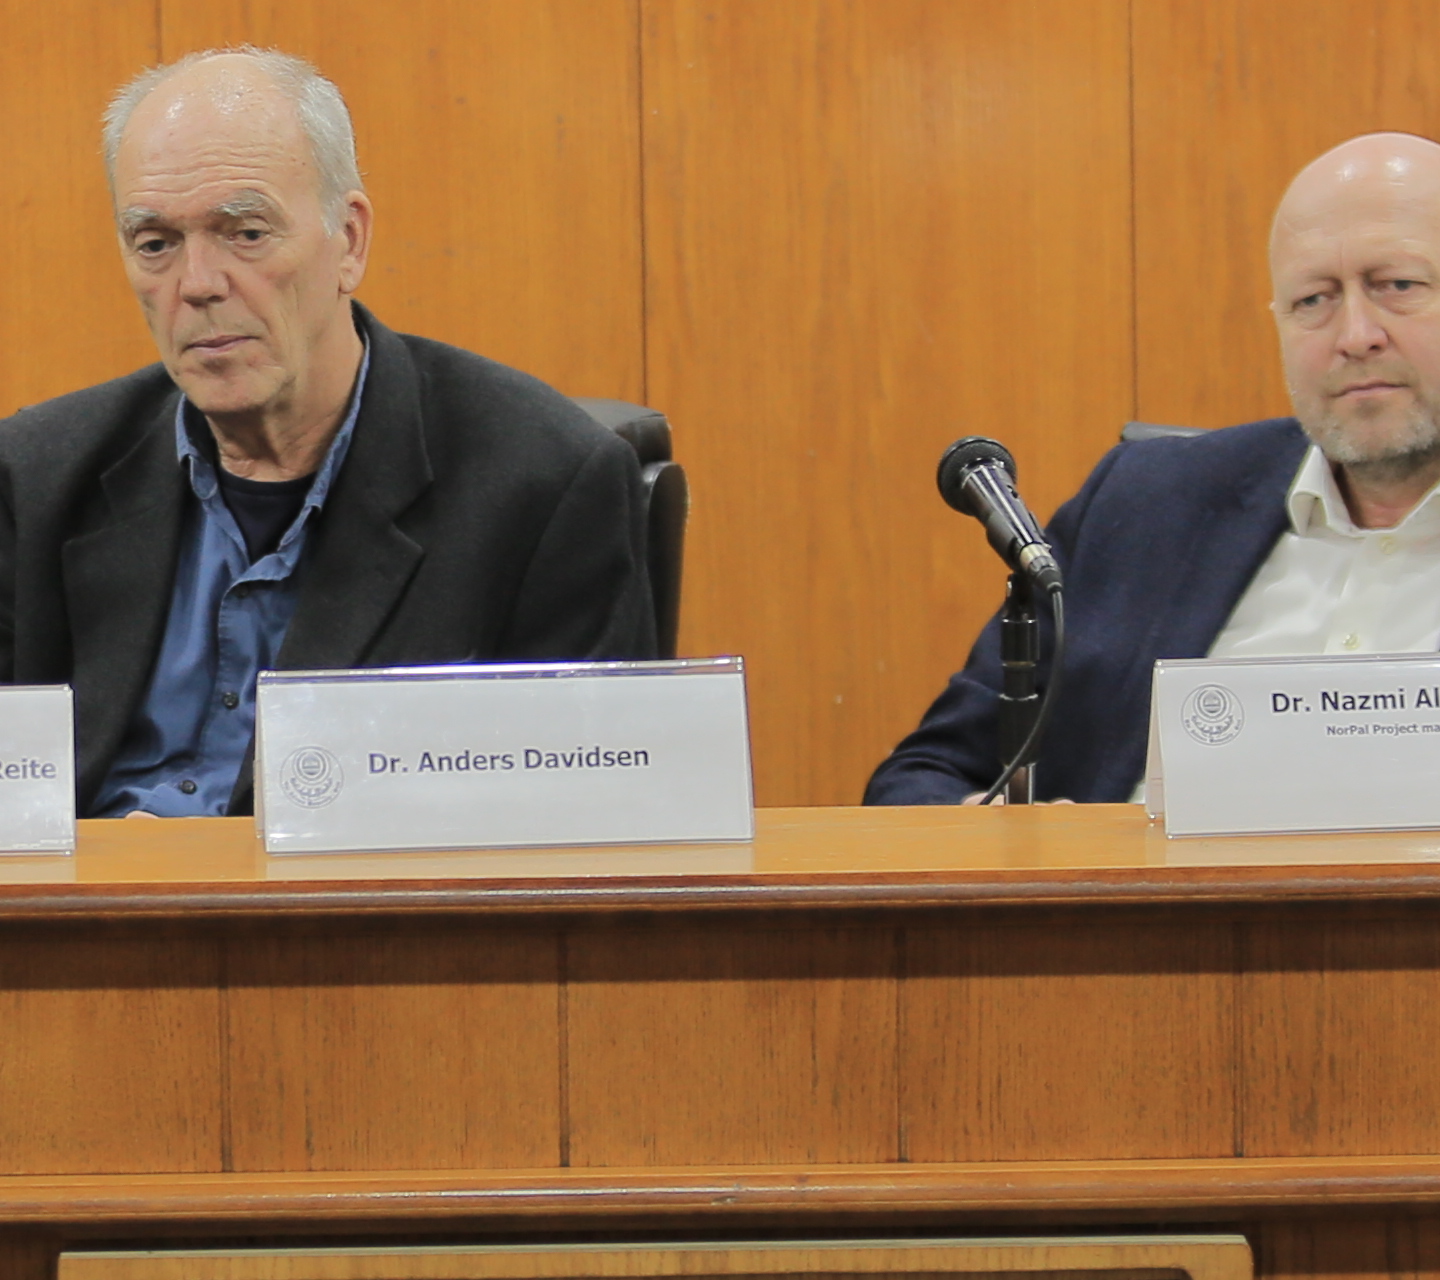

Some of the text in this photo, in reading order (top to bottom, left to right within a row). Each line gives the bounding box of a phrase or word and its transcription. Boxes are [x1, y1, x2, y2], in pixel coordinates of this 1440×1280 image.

[1272, 692, 1310, 713] Dr.
[1321, 688, 1405, 712] Nazmi
[1415, 687, 1440, 708] Al
[1326, 724, 1369, 736] NorPal
[1372, 723, 1418, 737] Project
[369, 746, 649, 774] Dr. Anders Davidsen
